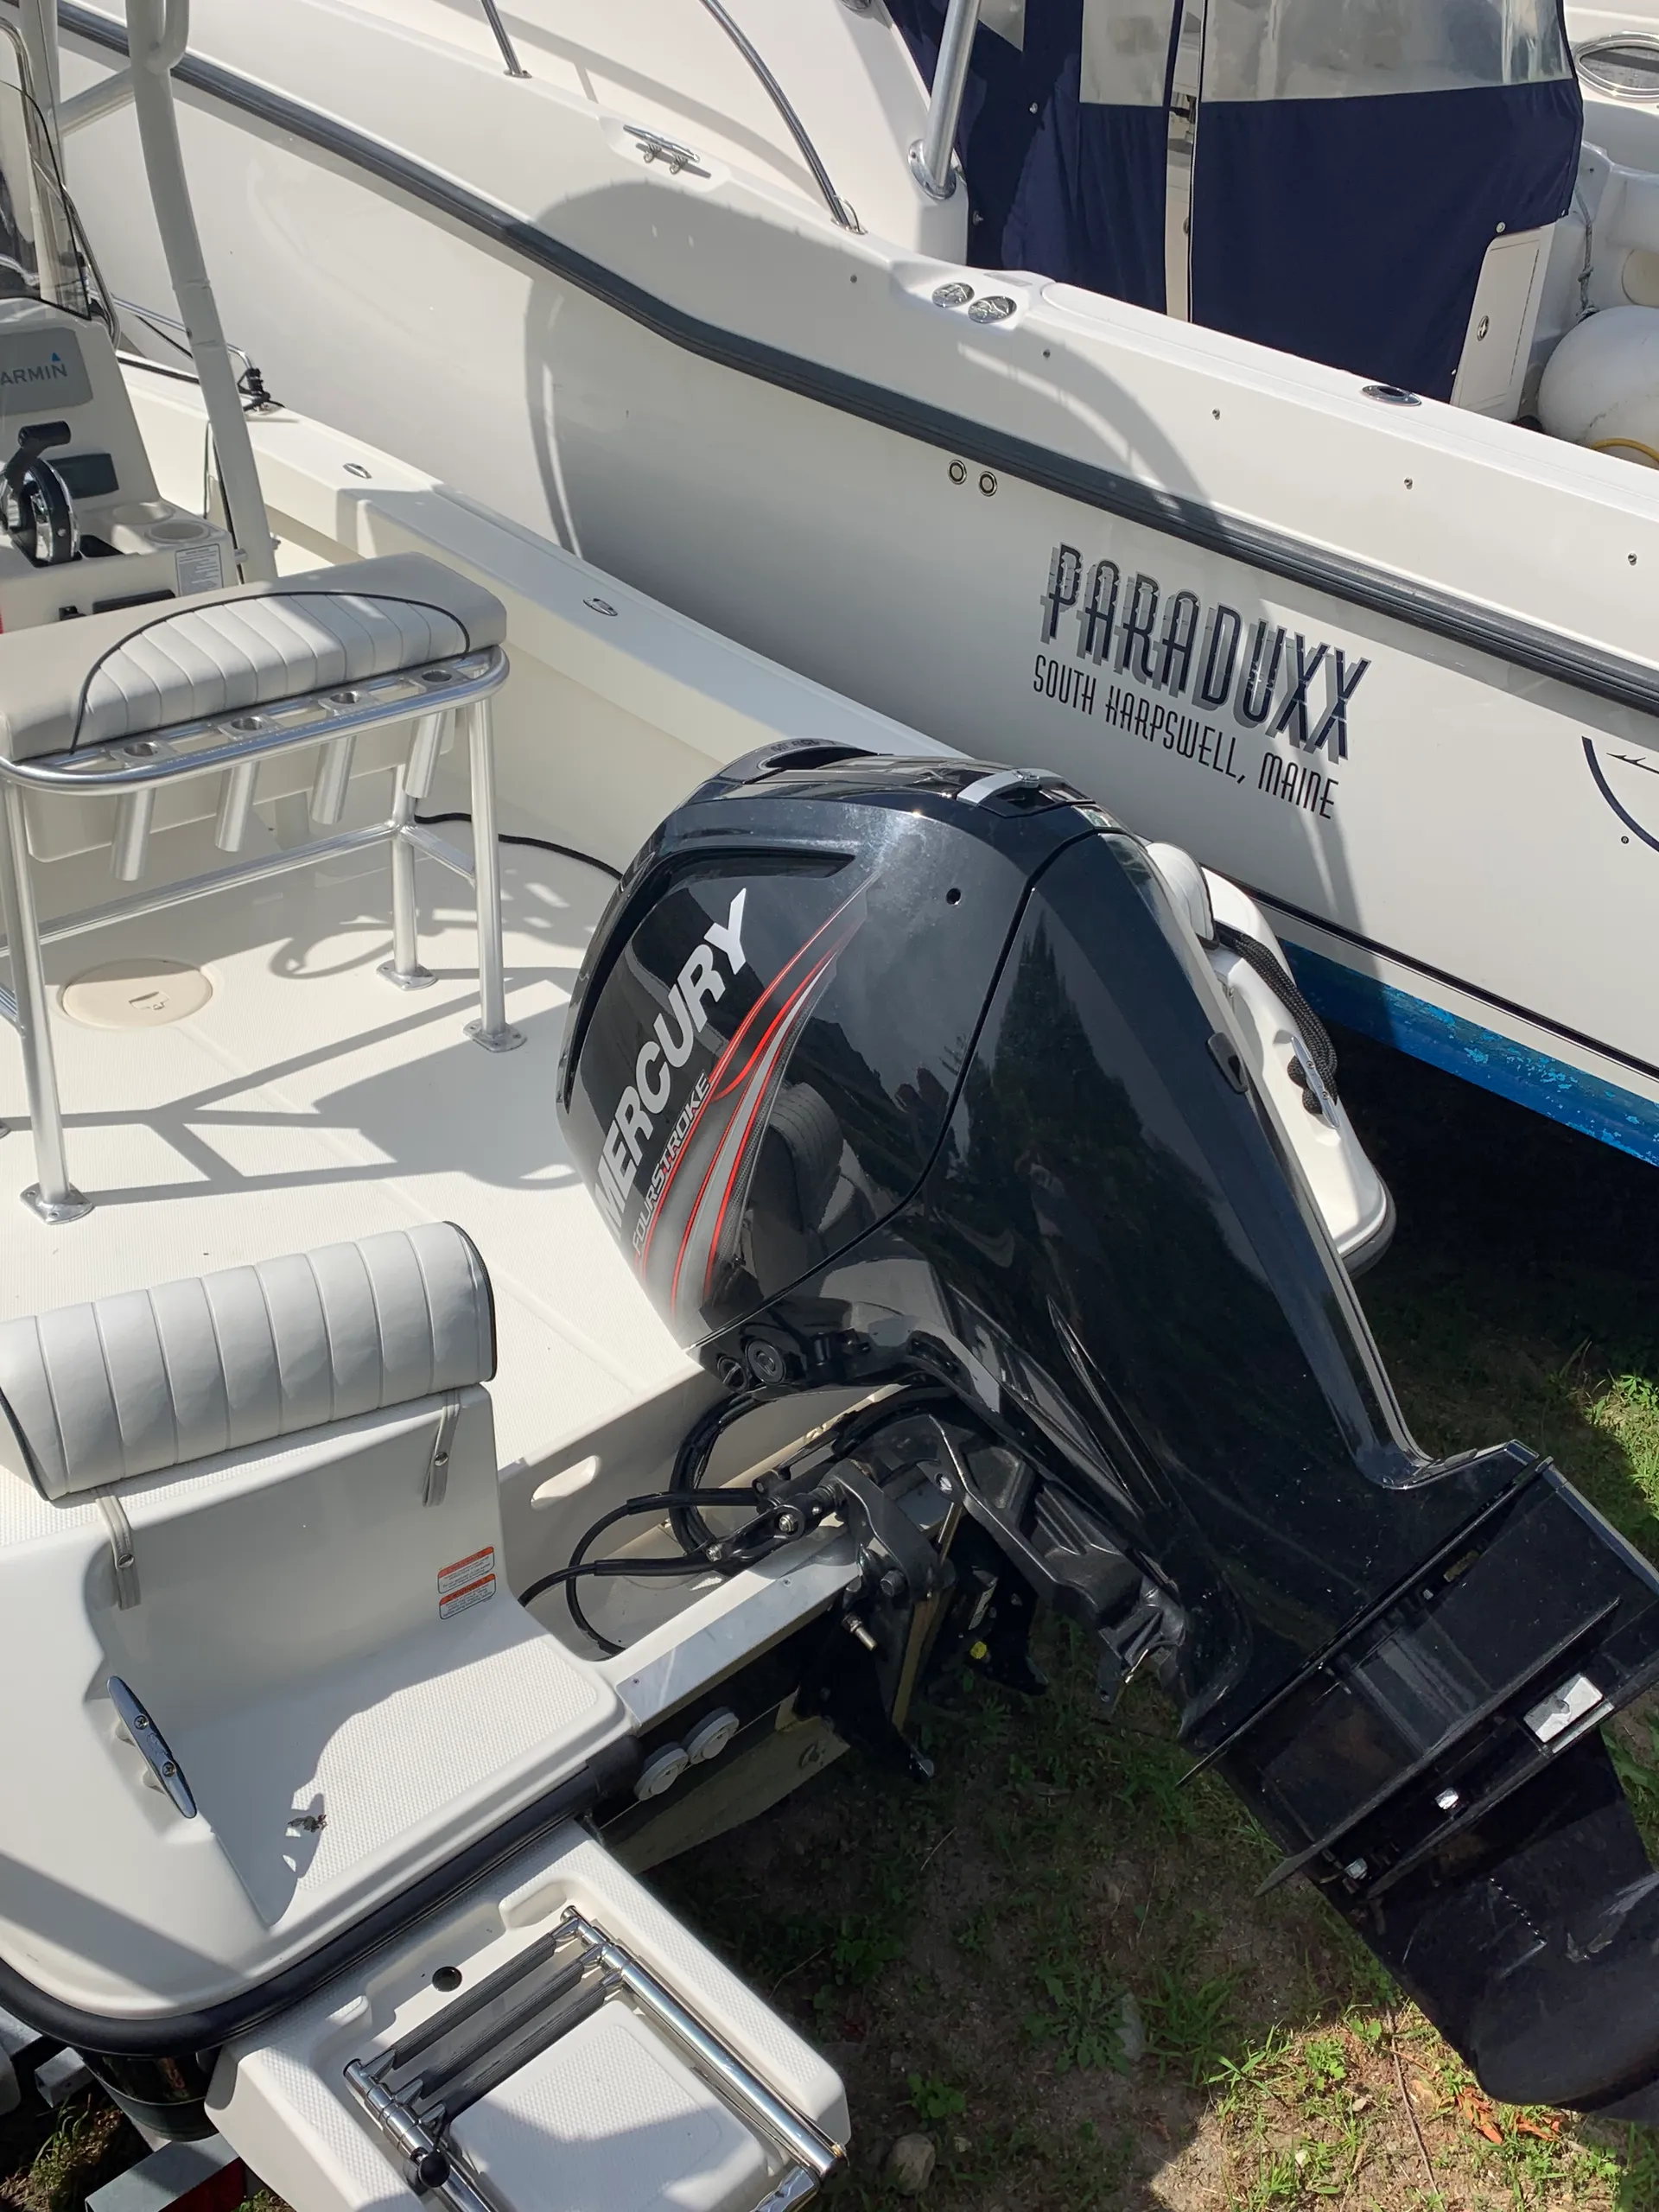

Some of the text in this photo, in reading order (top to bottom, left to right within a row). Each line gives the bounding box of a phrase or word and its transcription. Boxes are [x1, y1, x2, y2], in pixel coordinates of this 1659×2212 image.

[0, 363, 68, 385] ARMIN
[1033, 653, 1339, 820] SOUTH HARPSWELL, MAINE
[1040, 542, 1372, 765] PARADUXX
[594, 887, 747, 1242] MERCURY
[632, 1071, 711, 1257] FOURSTROKE
